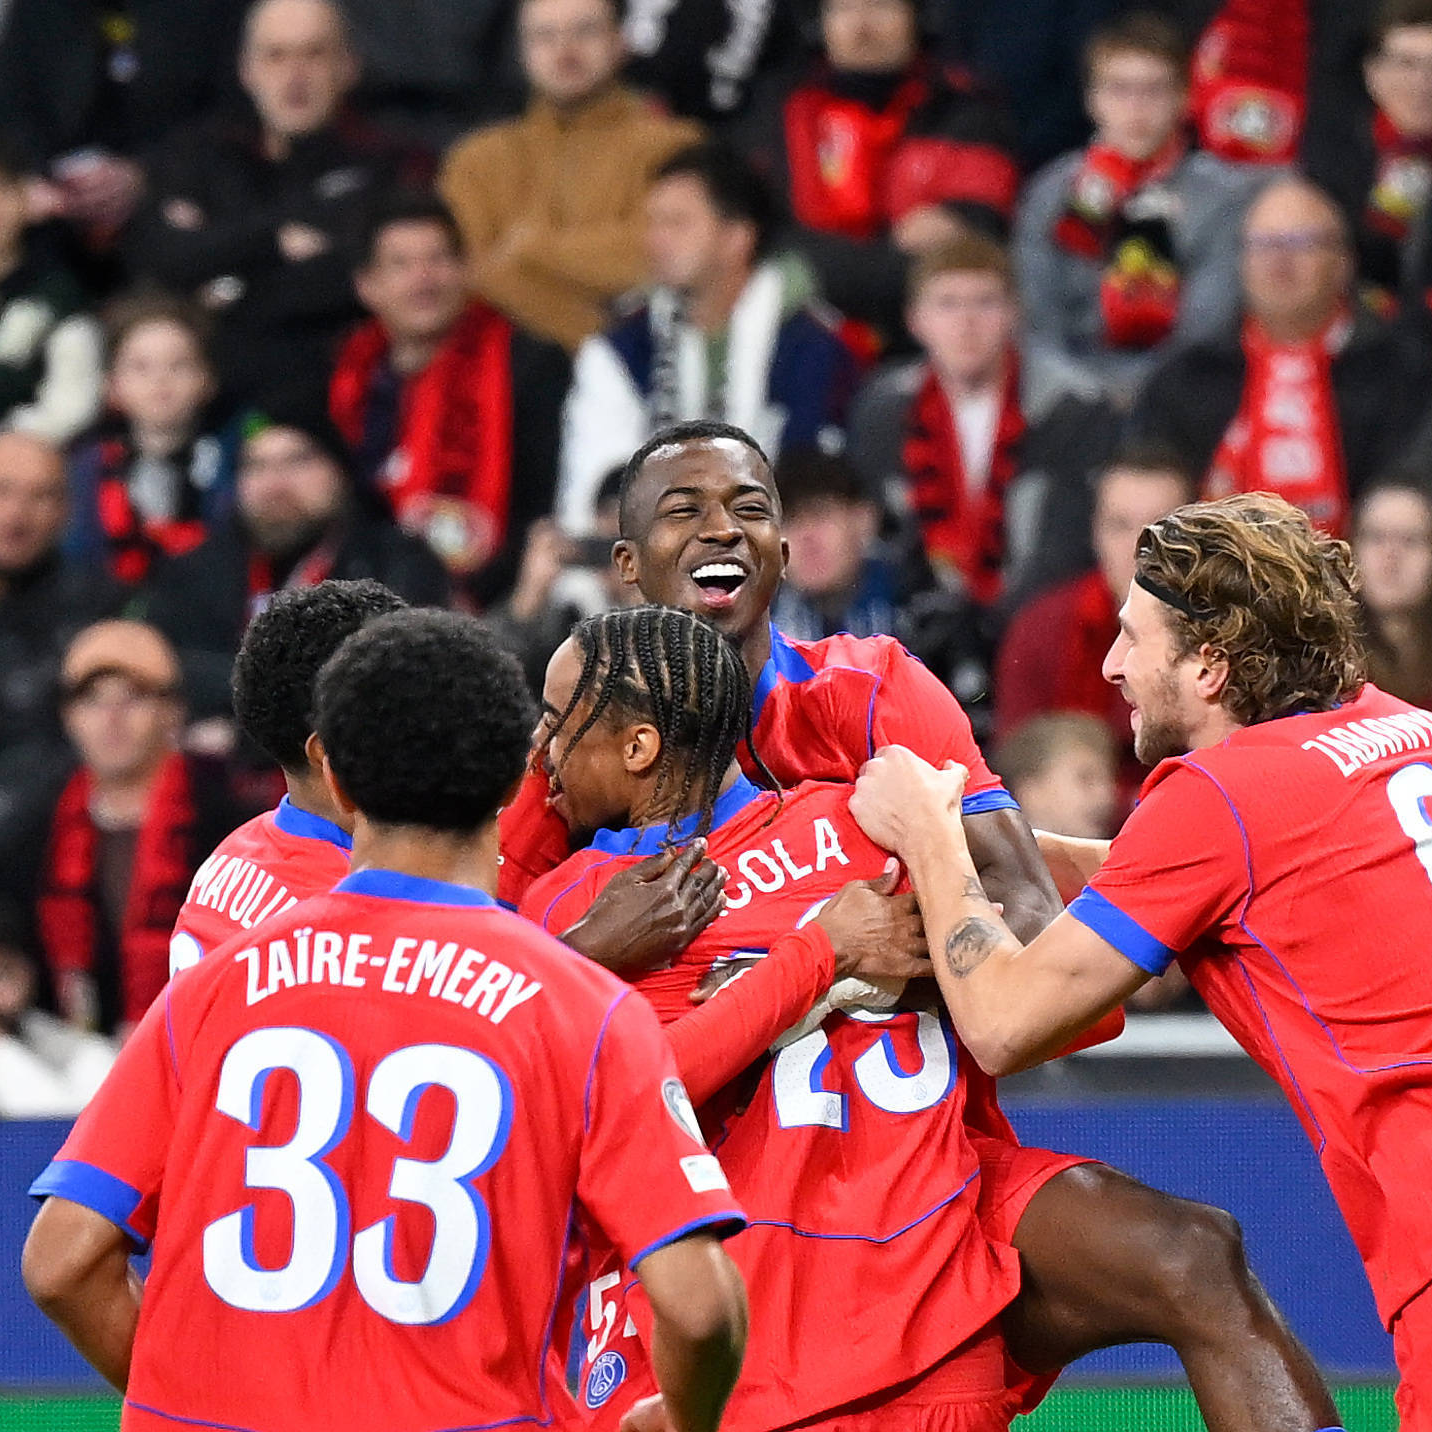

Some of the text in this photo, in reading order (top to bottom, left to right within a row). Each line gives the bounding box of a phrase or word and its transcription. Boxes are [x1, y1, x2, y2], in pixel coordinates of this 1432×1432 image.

[717, 817, 851, 918] COLA
[234, 926, 543, 1025] ZAÏRE-EMERY
[202, 1025, 515, 1326] 33
